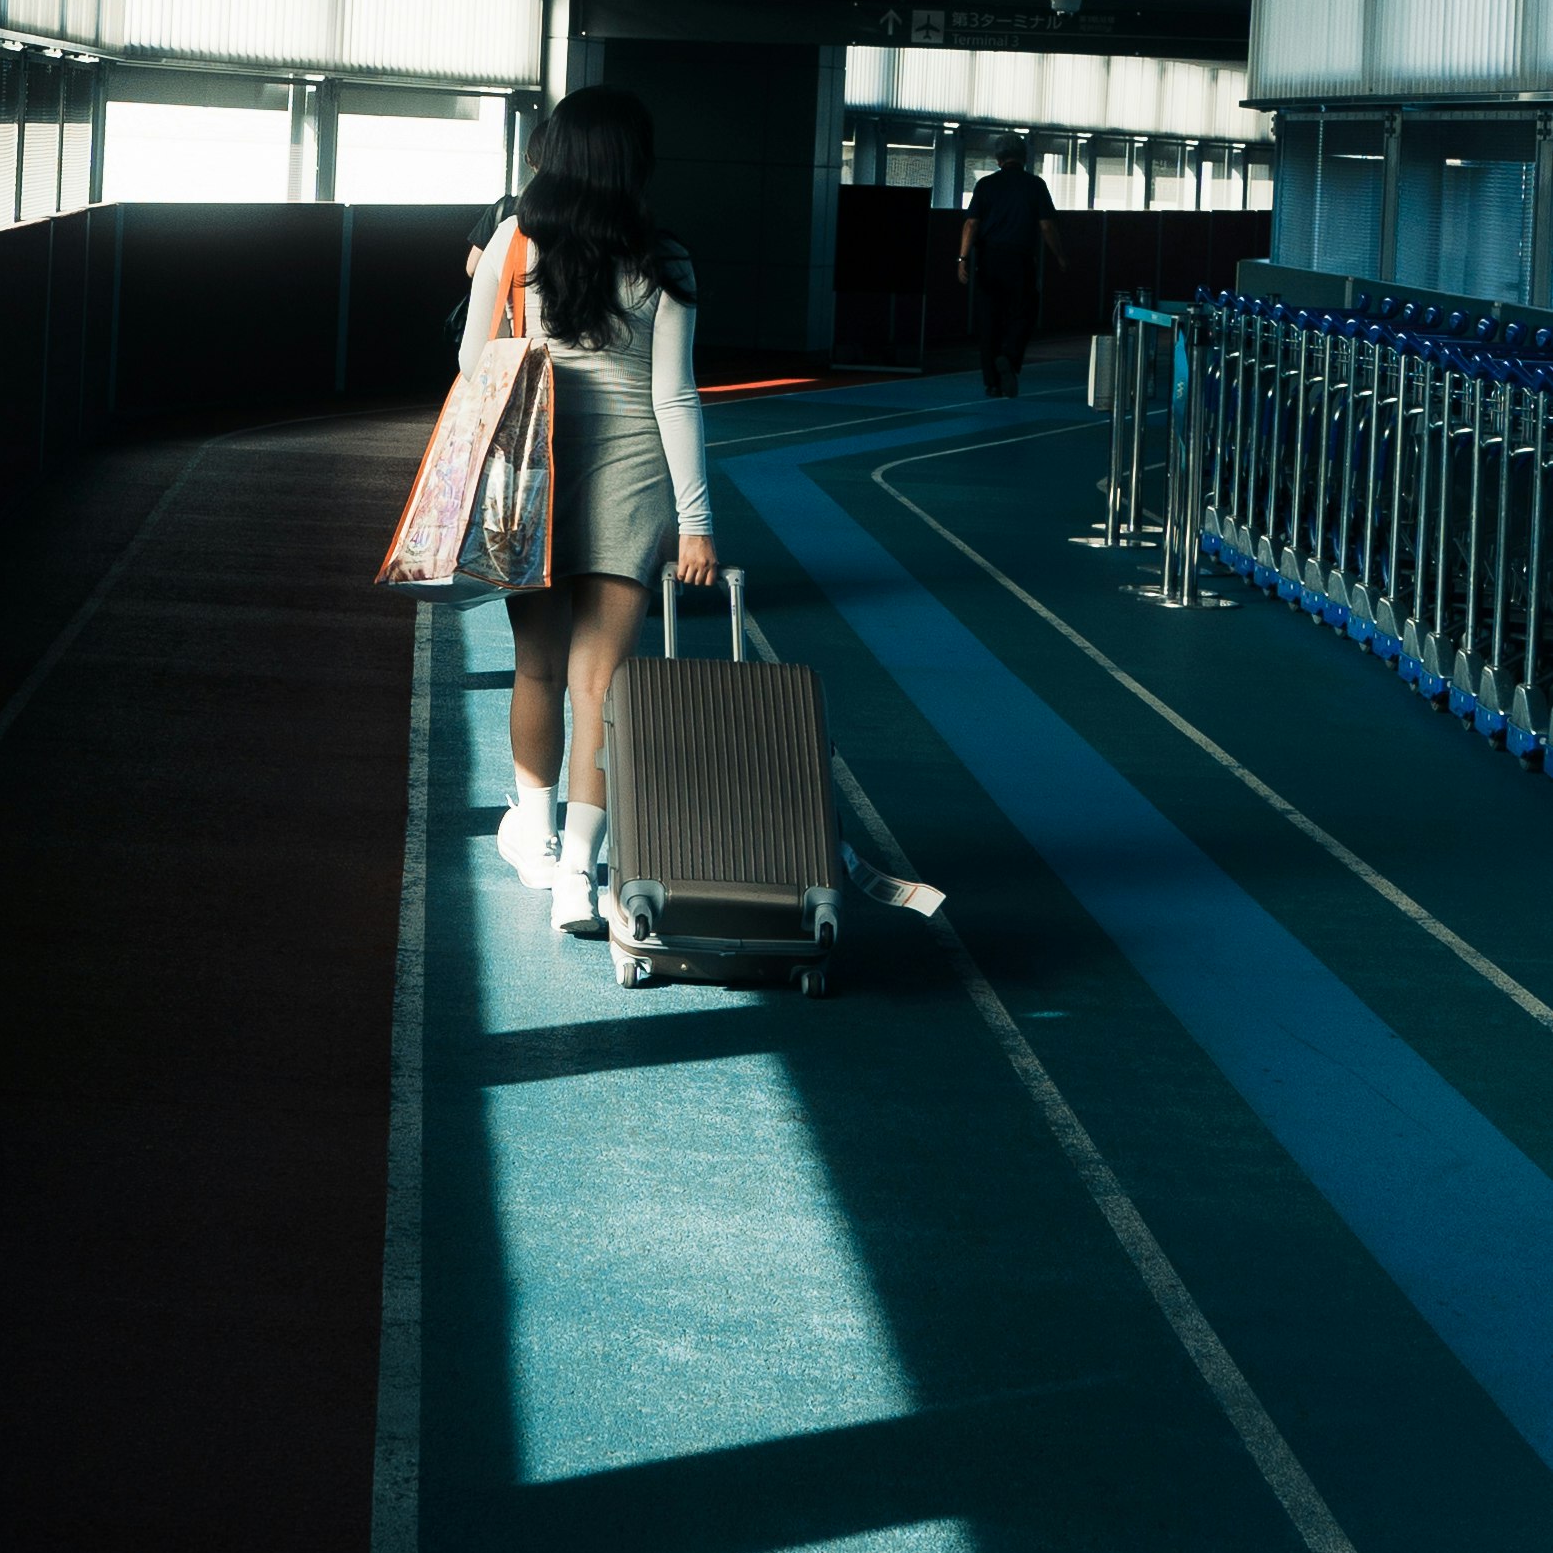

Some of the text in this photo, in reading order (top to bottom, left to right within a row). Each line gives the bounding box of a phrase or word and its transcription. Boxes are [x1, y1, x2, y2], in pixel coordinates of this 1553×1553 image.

[951, 11, 1063, 30] 第3ターミナル
[952, 34, 1020, 48] Terminal 3
